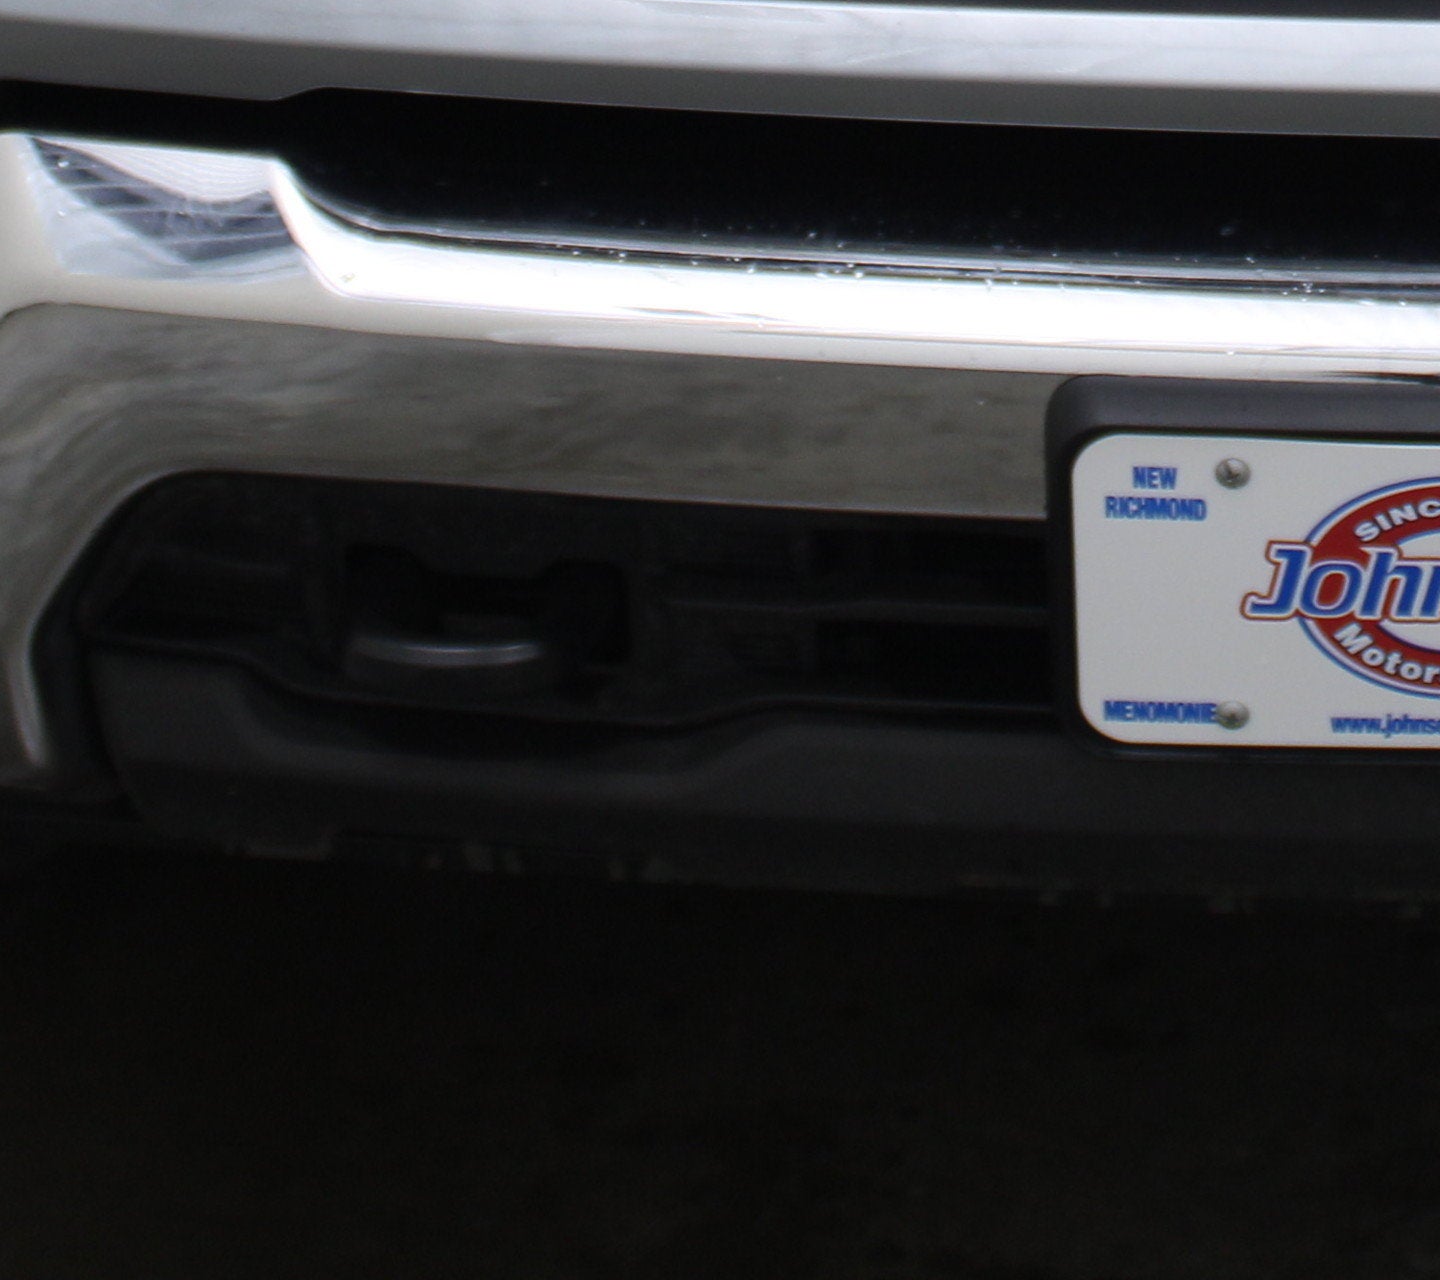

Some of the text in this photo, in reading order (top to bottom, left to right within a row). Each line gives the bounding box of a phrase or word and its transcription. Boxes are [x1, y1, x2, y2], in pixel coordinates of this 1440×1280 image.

[1132, 466, 1178, 489] NEW
[1105, 496, 1207, 521] RICHMOND
[1104, 700, 1219, 725] MENOMONIE
